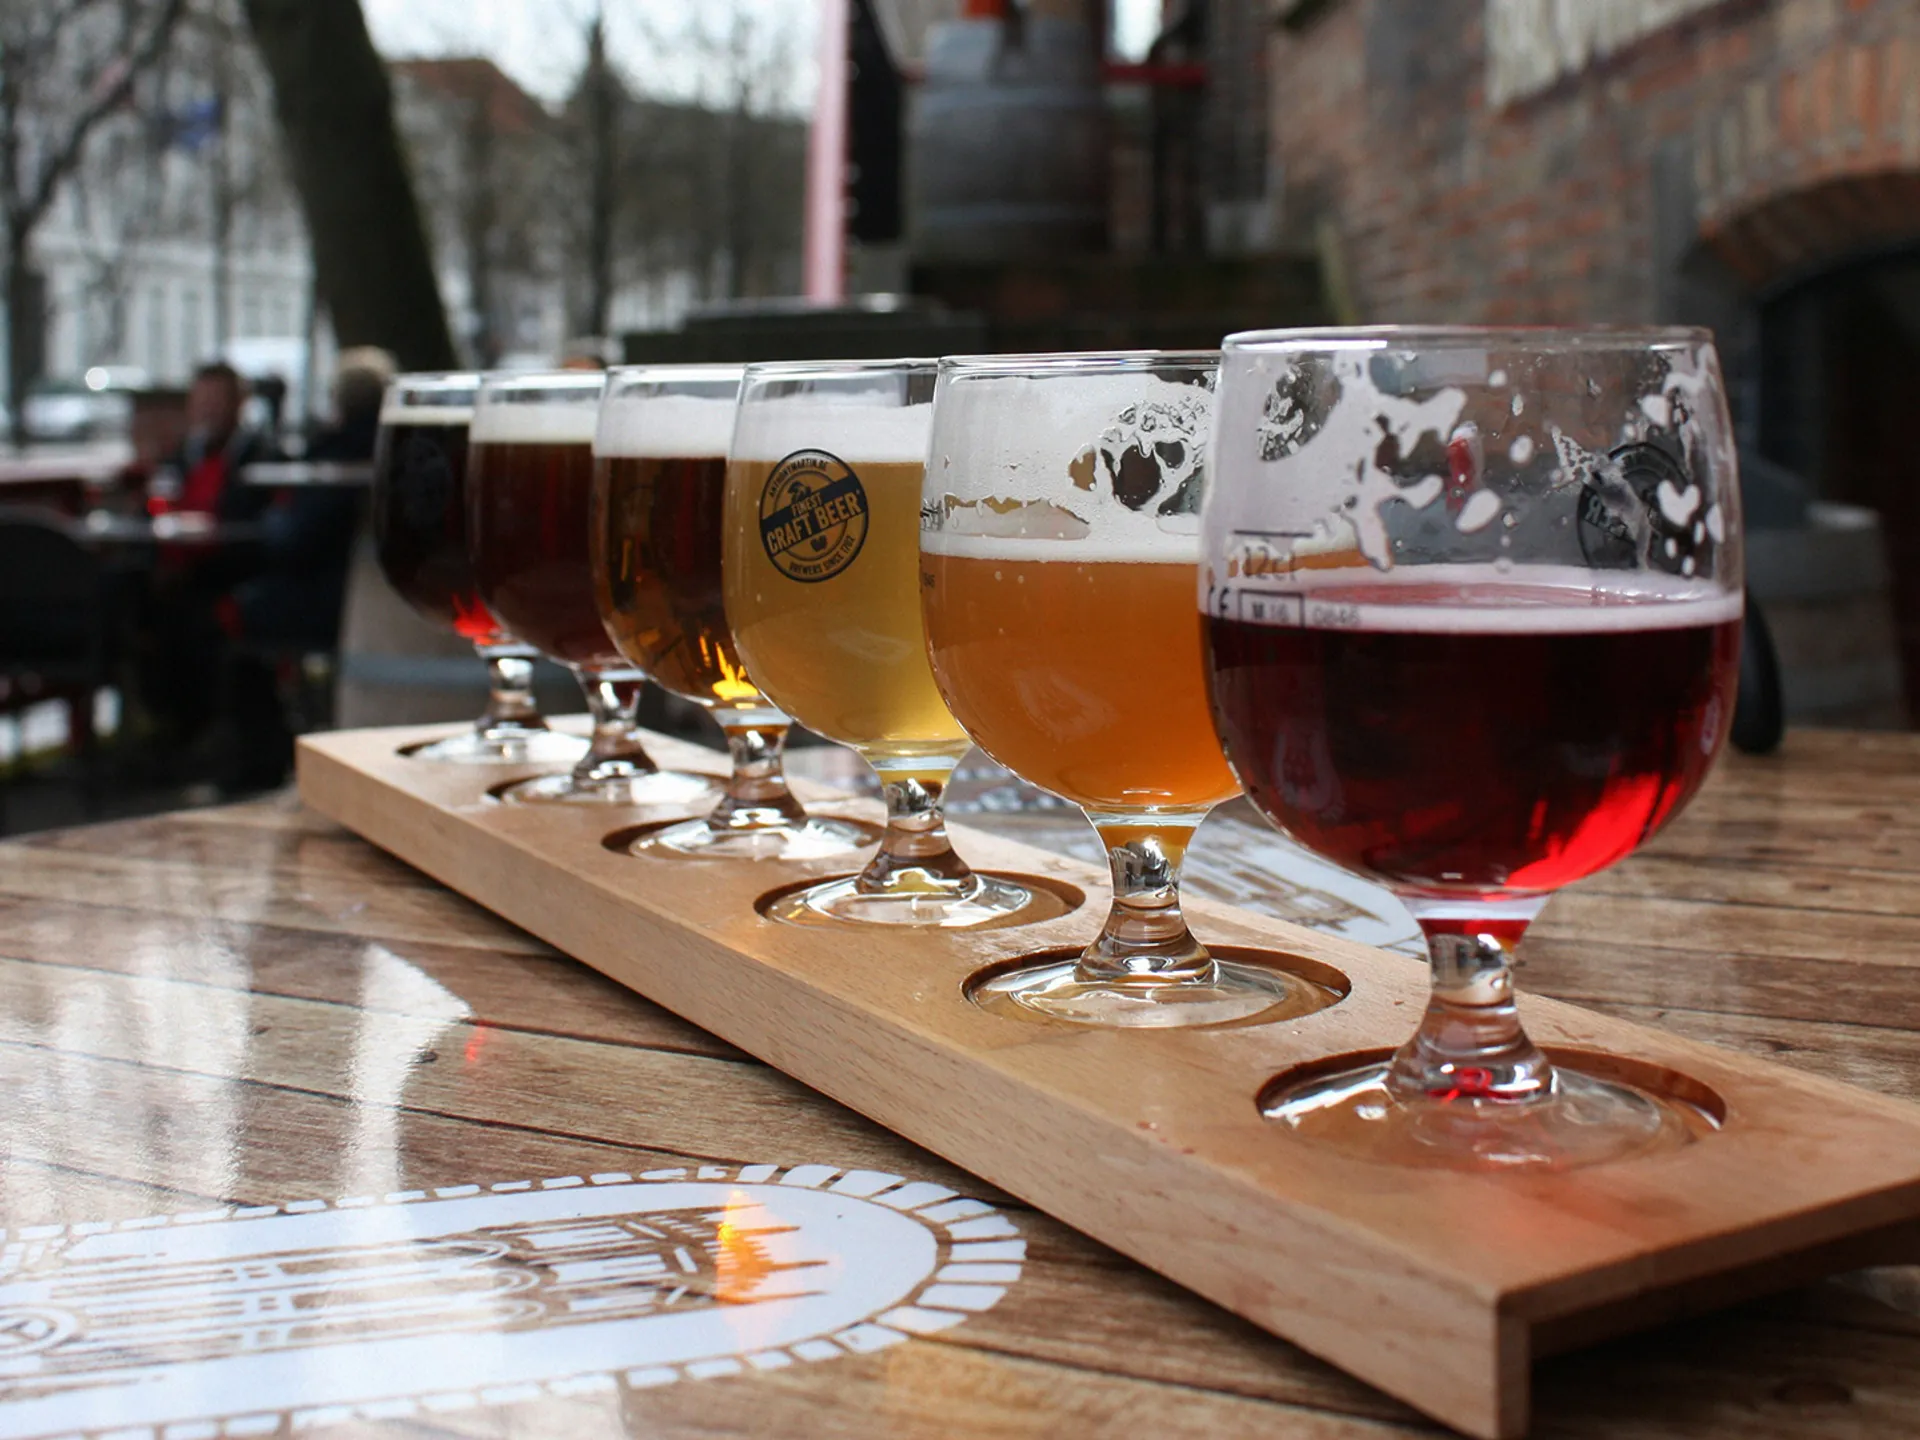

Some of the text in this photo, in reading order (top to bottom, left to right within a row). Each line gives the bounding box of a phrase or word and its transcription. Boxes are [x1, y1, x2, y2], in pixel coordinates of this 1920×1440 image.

[792, 492, 823, 516] FINEST
[767, 491, 862, 554] CRAFT BEER
[823, 551, 844, 571] SINCE
